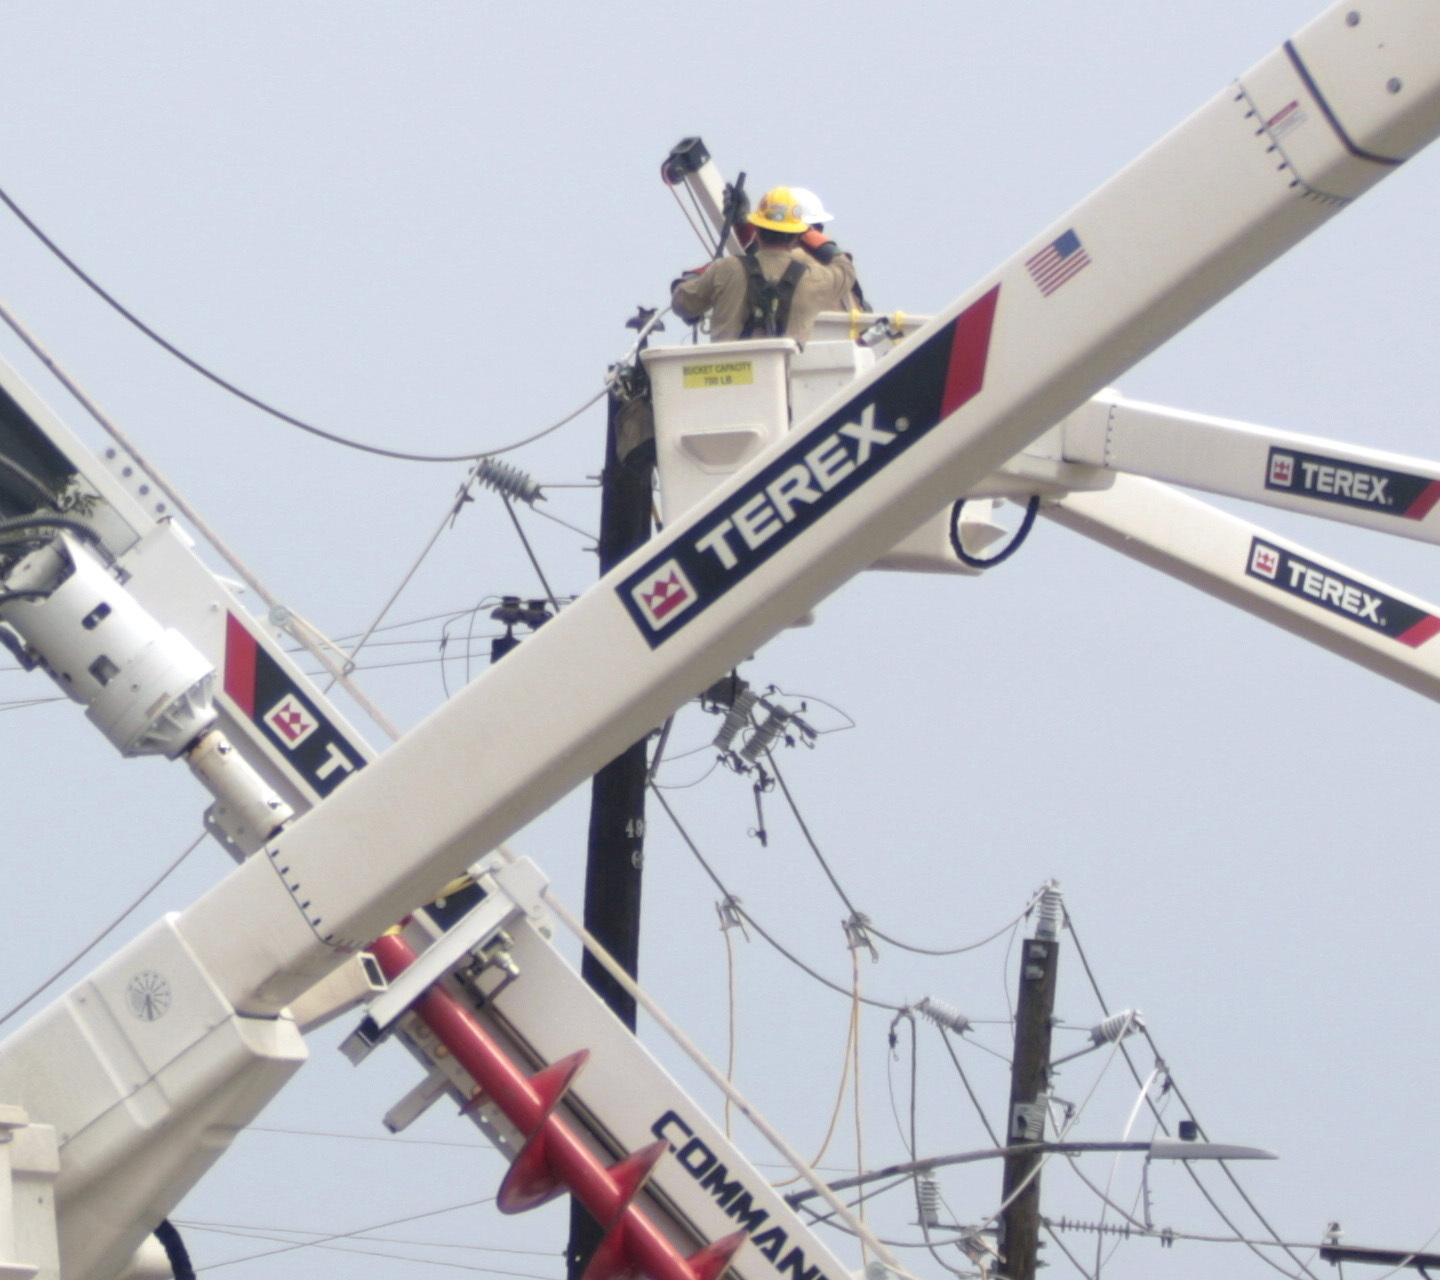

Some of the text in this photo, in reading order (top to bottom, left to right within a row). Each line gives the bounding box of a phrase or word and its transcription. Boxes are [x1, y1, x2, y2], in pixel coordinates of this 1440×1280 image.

[695, 403, 897, 571] TEREX
[1301, 460, 1389, 506] TEREX
[1287, 559, 1386, 625] TEREX
